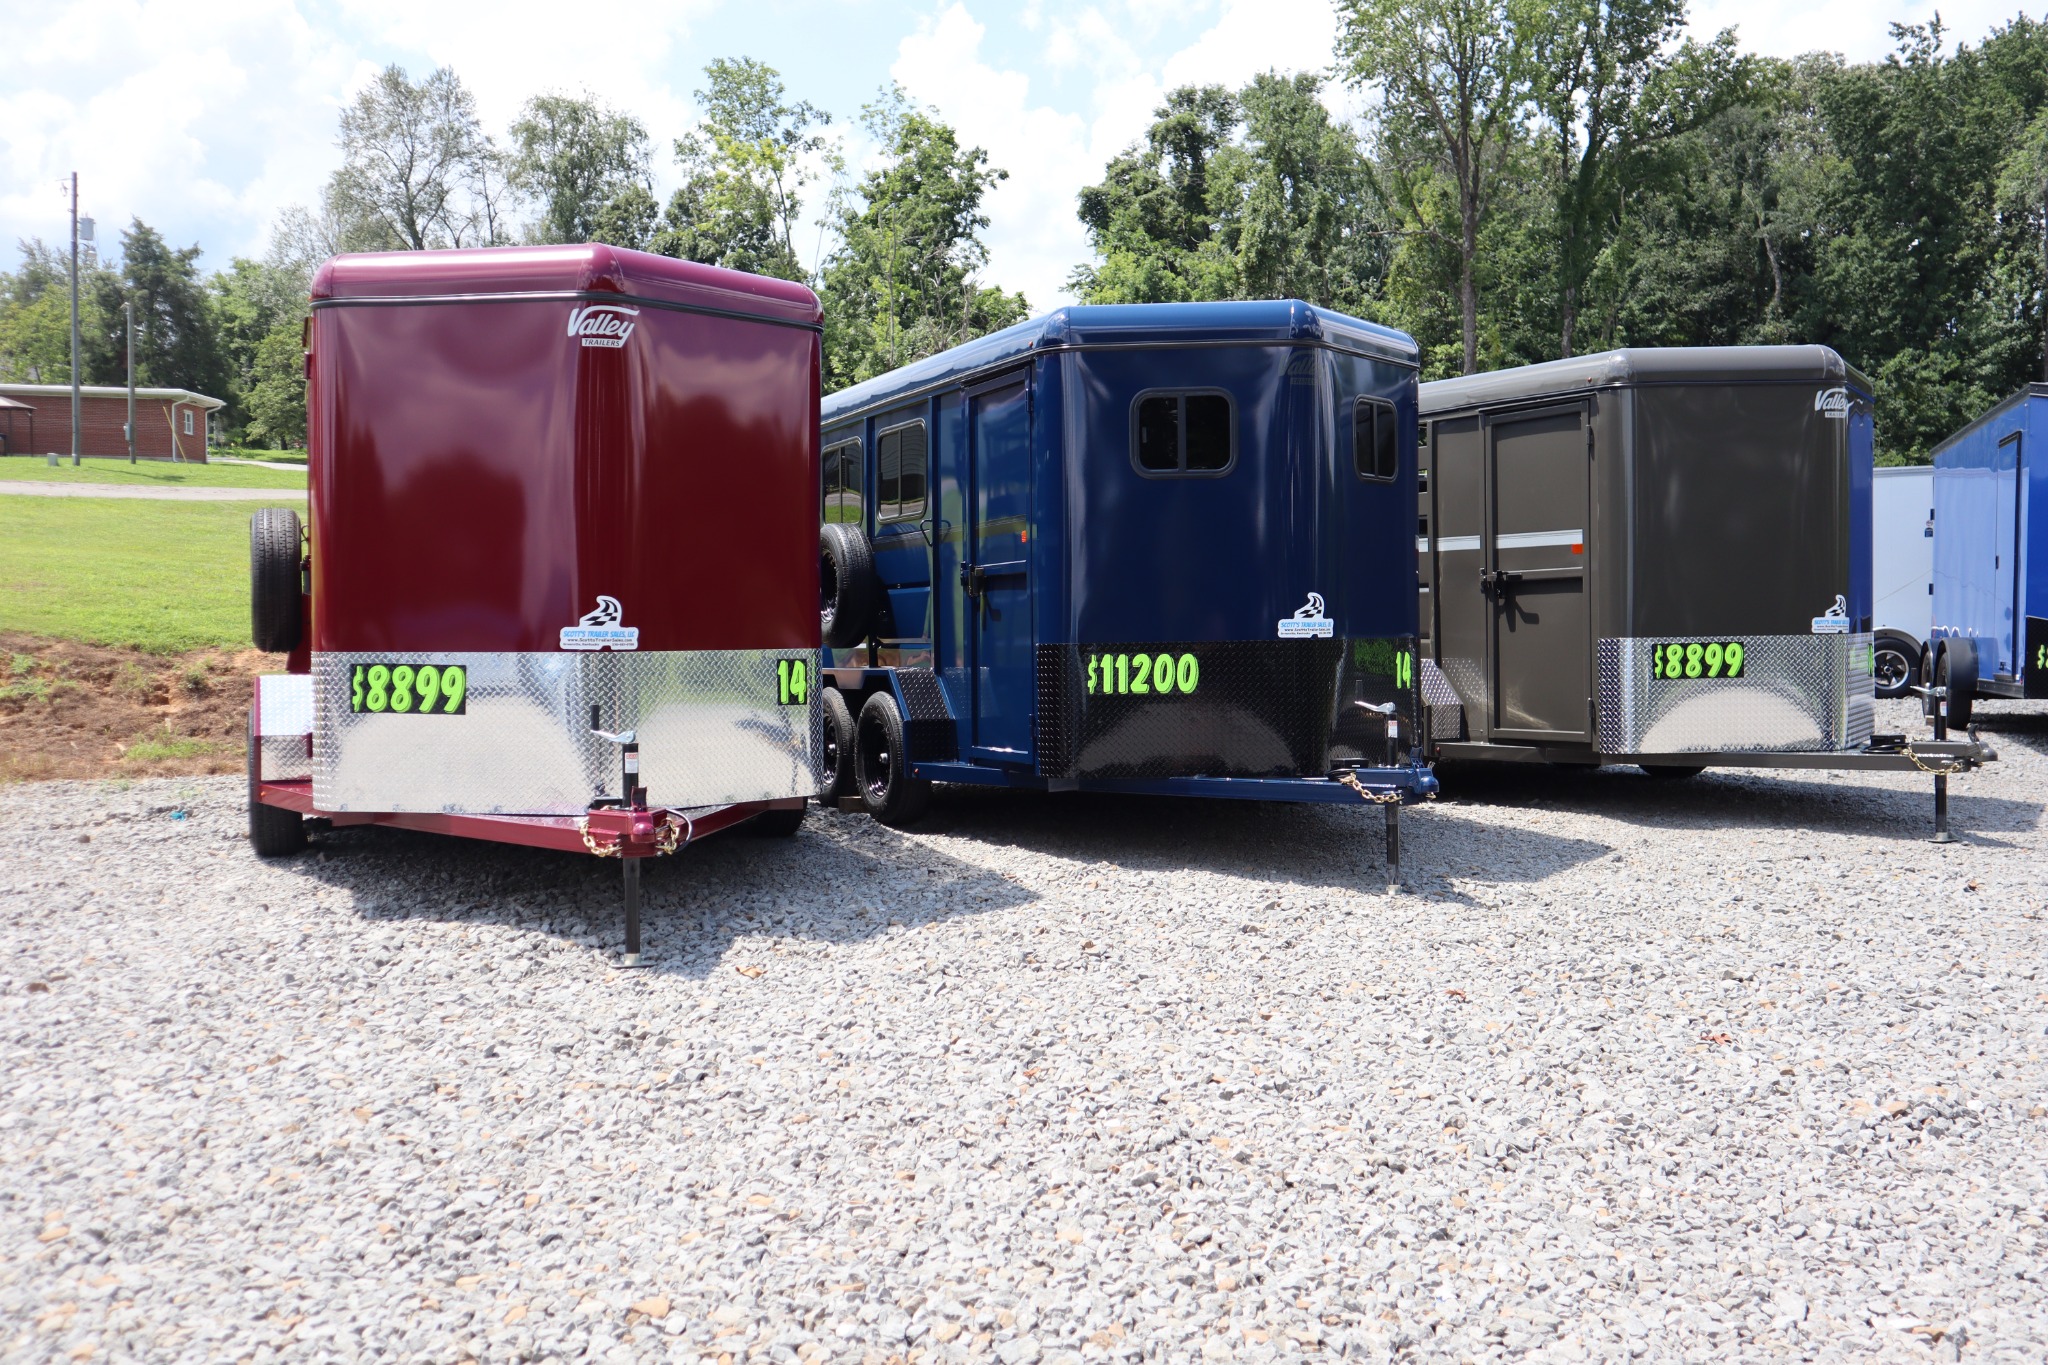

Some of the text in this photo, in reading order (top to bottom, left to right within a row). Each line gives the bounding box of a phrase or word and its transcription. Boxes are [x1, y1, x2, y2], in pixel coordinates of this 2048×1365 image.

[567, 305, 640, 347] Valley
[584, 339, 620, 347] TRAILERS
[563, 630, 586, 638] SCOTT'S
[588, 630, 609, 638] TRAILER
[1087, 653, 1200, 695] $11200
[1395, 651, 1412, 690] 14
[1654, 642, 1744, 680] $8899
[352, 664, 466, 714] $8899
[777, 659, 807, 705] 14
